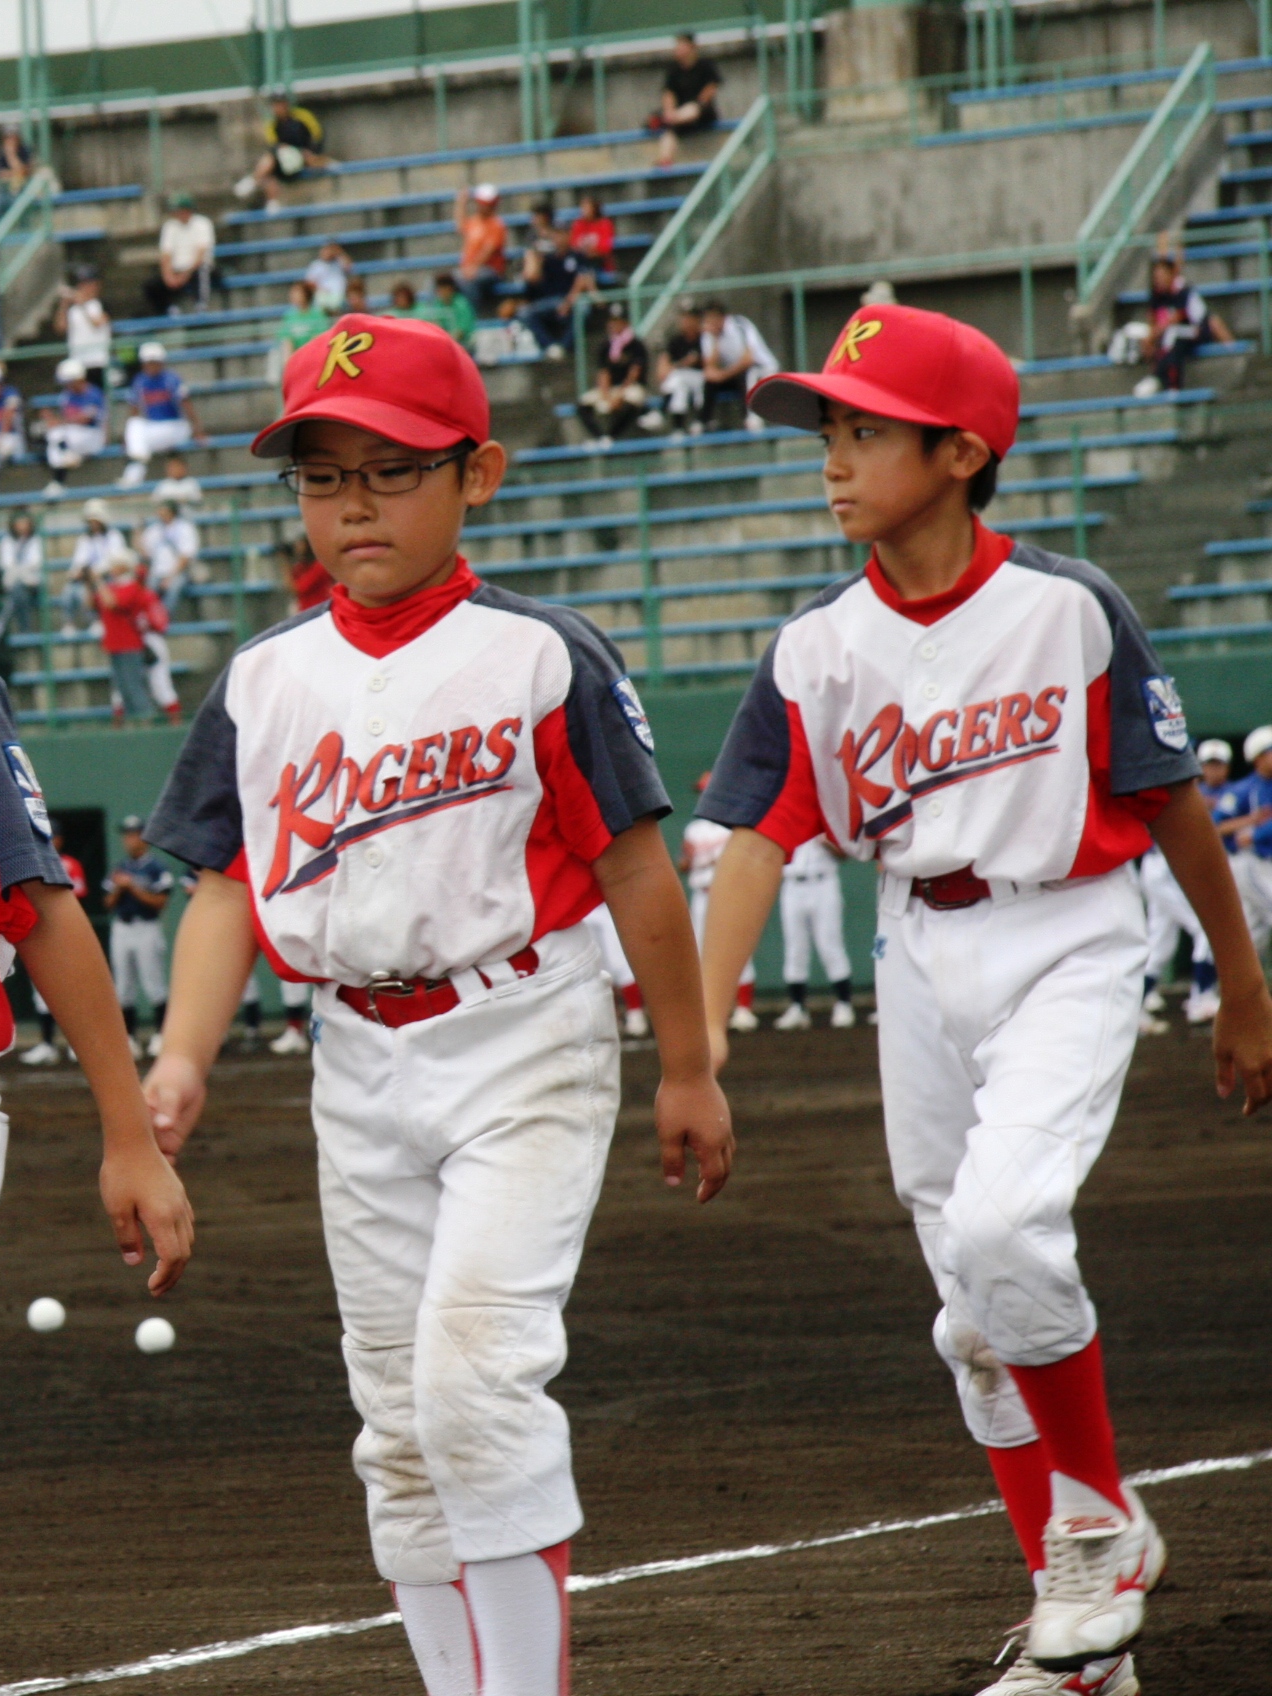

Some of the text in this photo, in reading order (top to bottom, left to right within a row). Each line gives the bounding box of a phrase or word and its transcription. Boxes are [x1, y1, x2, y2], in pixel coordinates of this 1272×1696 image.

[317, 330, 375, 391] R
[829, 319, 883, 368] R
[262, 717, 523, 901] ROGERS
[834, 685, 1068, 842] ROGERS
